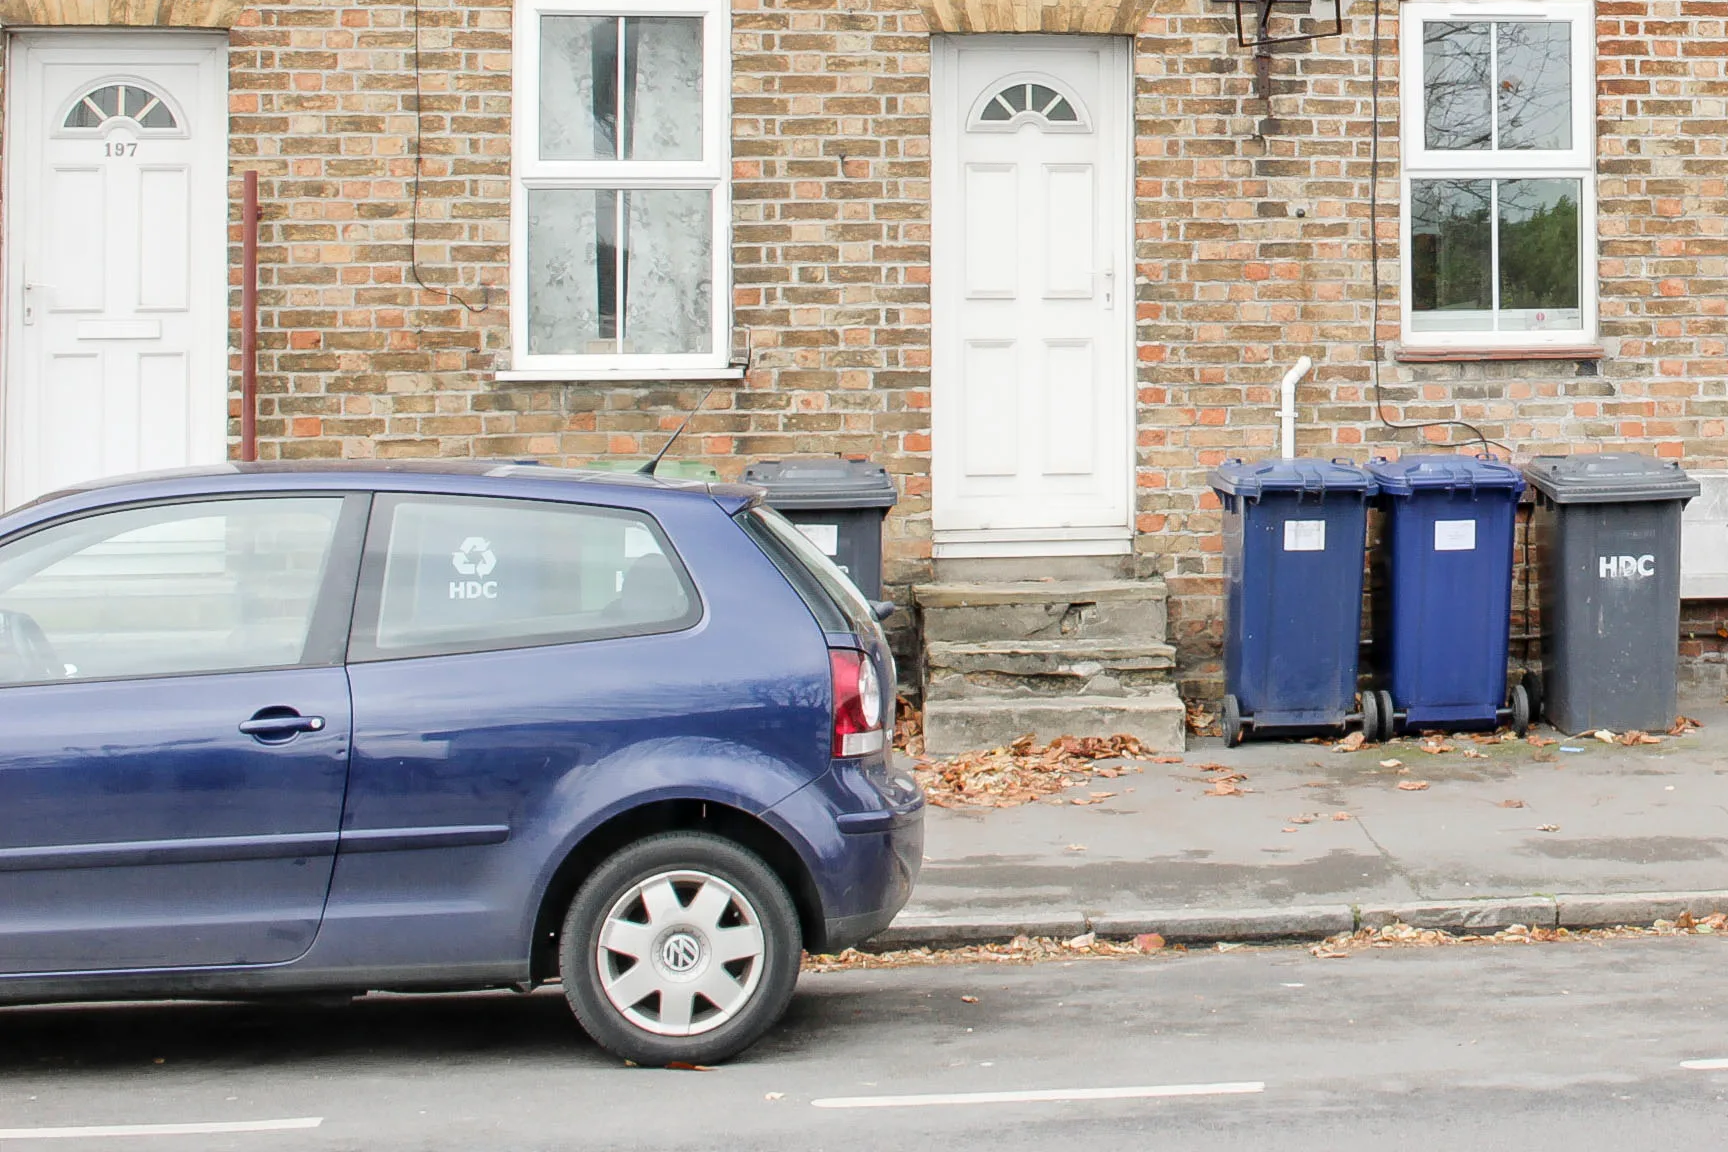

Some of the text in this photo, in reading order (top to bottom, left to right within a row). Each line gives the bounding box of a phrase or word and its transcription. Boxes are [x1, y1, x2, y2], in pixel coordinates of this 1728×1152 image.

[104, 142, 138, 157] 197
[1599, 554, 1656, 579] HDC
[448, 580, 498, 600] HDC
